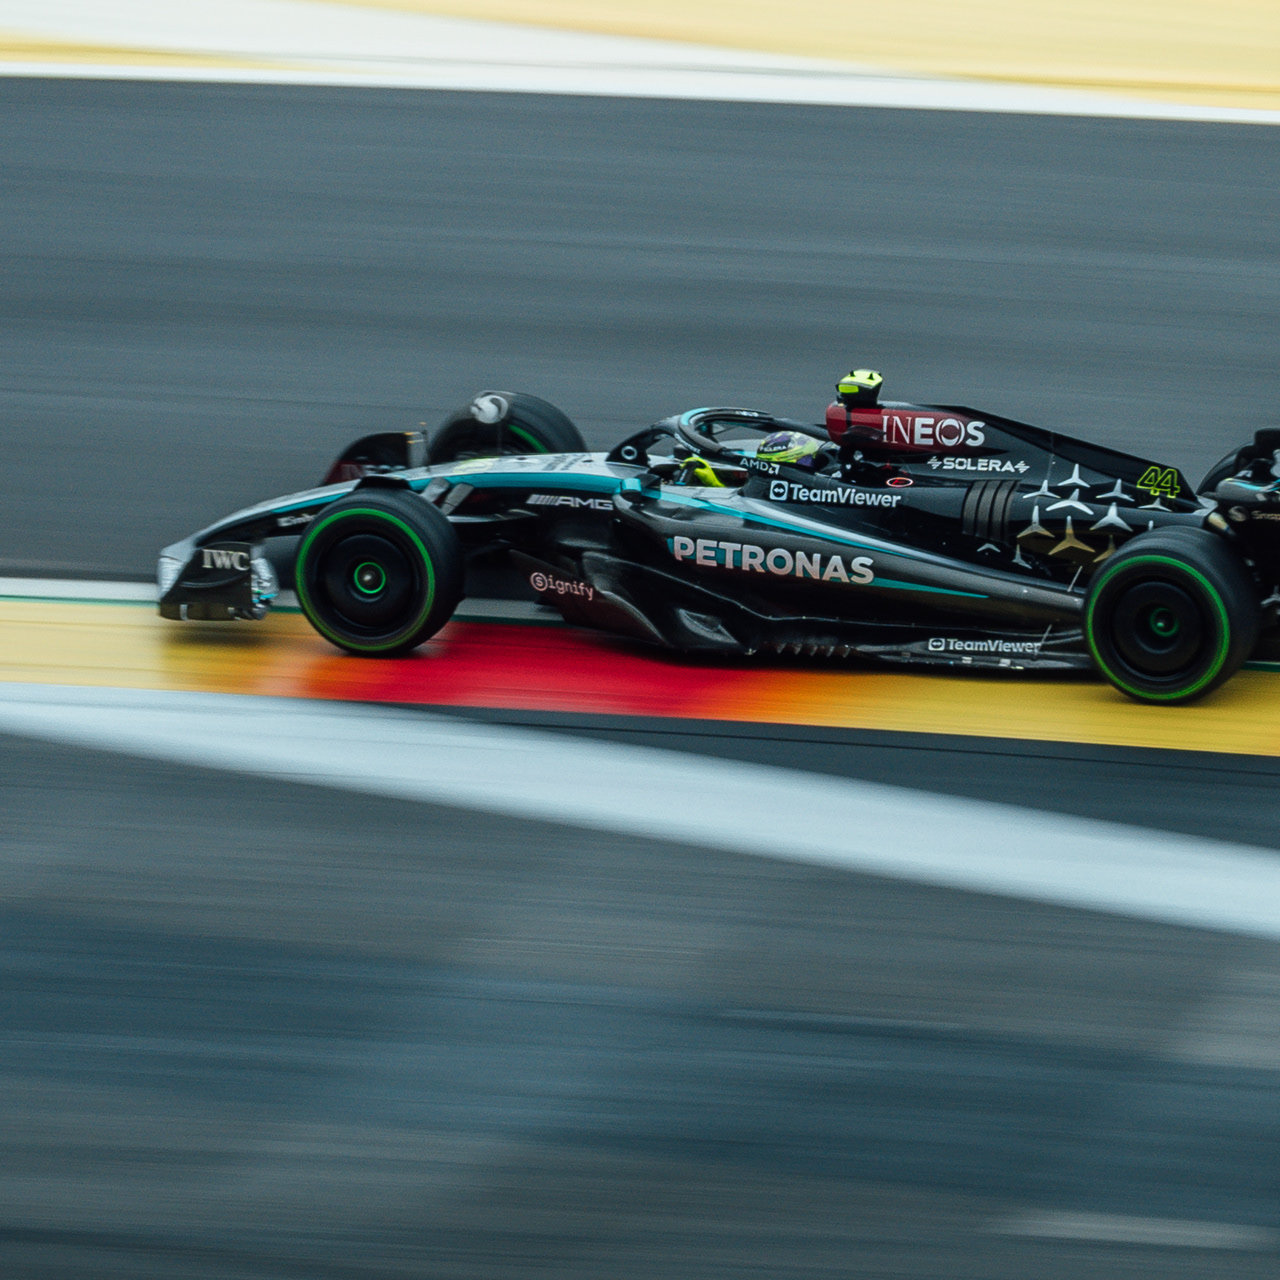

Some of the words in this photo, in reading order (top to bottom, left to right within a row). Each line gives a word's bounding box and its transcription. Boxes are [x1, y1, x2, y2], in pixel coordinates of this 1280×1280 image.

[882, 415, 986, 447] INEOS
[739, 457, 768, 471] AMD
[942, 457, 1015, 473] SOLERA
[1136, 466, 1181, 499] 44
[555, 495, 614, 511] AMG
[789, 483, 902, 508] TeamViewer
[202, 548, 250, 571] IWC
[673, 535, 875, 585] PETRONAS
[947, 638, 1041, 654] TeamViewer
